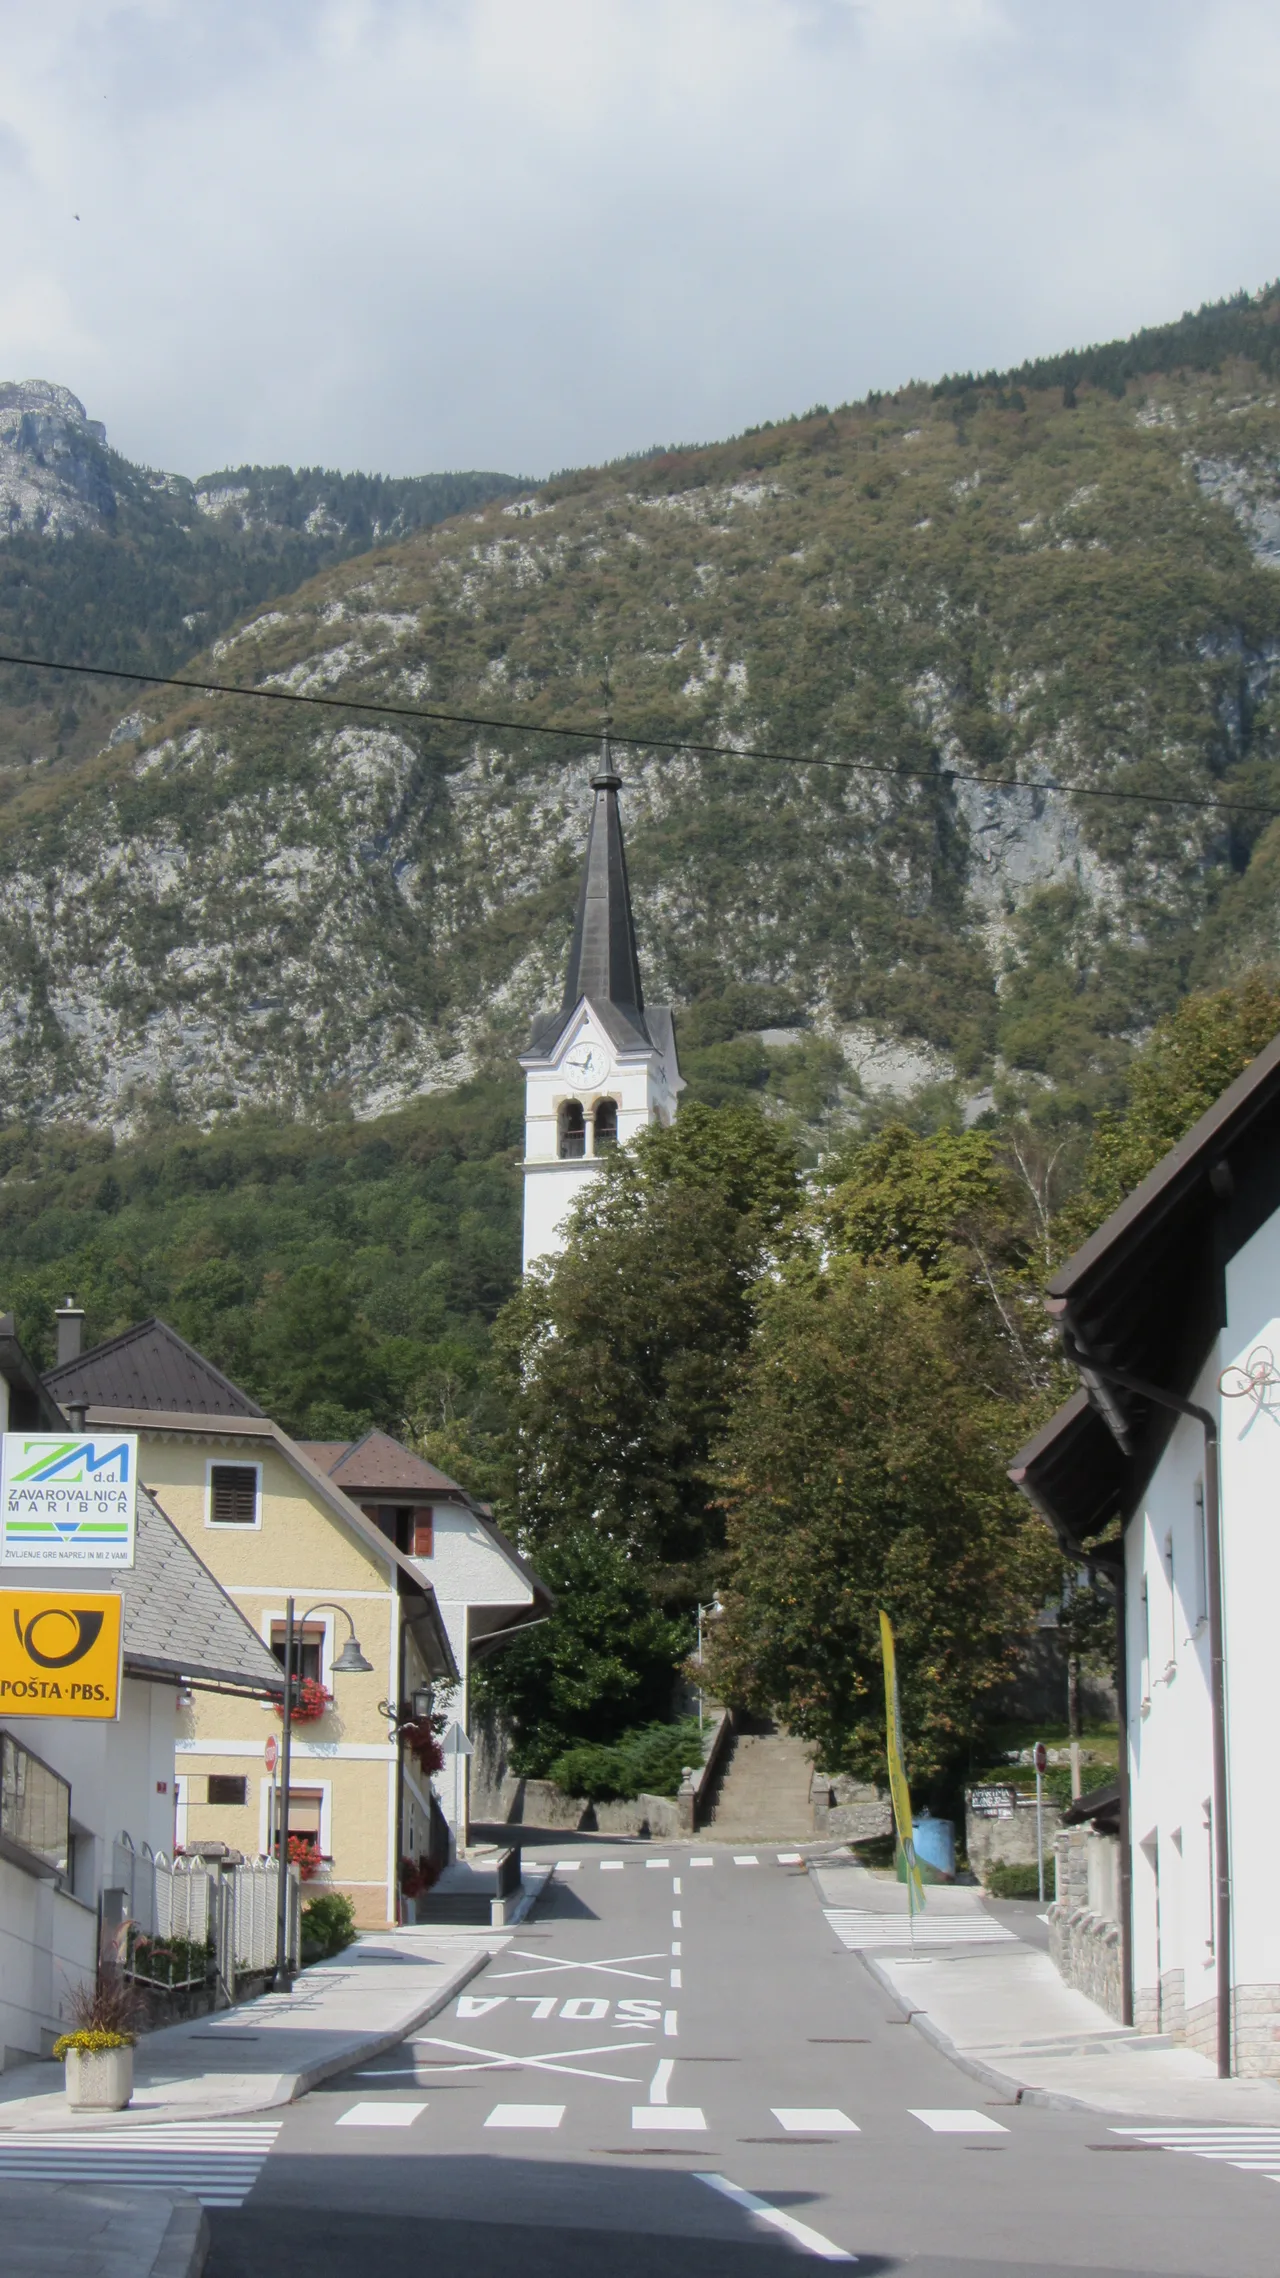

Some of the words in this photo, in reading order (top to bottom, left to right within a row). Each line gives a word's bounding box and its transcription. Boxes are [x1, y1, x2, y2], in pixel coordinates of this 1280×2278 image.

[93, 1472, 119, 1483] d.d.
[8, 1489, 128, 1501] ZAVAROVALNICA
[8, 1501, 127, 1513] MARIBOR
[5, 1549, 41, 1559] ŽIVLJENJE
[42, 1551, 57, 1559] GRE
[59, 1551, 86, 1560] NAPREJ
[87, 1552, 95, 1560] IN
[96, 1552, 104, 1560] MI
[105, 1552, 110, 1560] Z
[111, 1552, 128, 1560] VAMI
[0, 1676, 62, 1699] POŠTA
[70, 1683, 110, 1702] PBS.
[456, 1996, 662, 2028] ŠOLA
